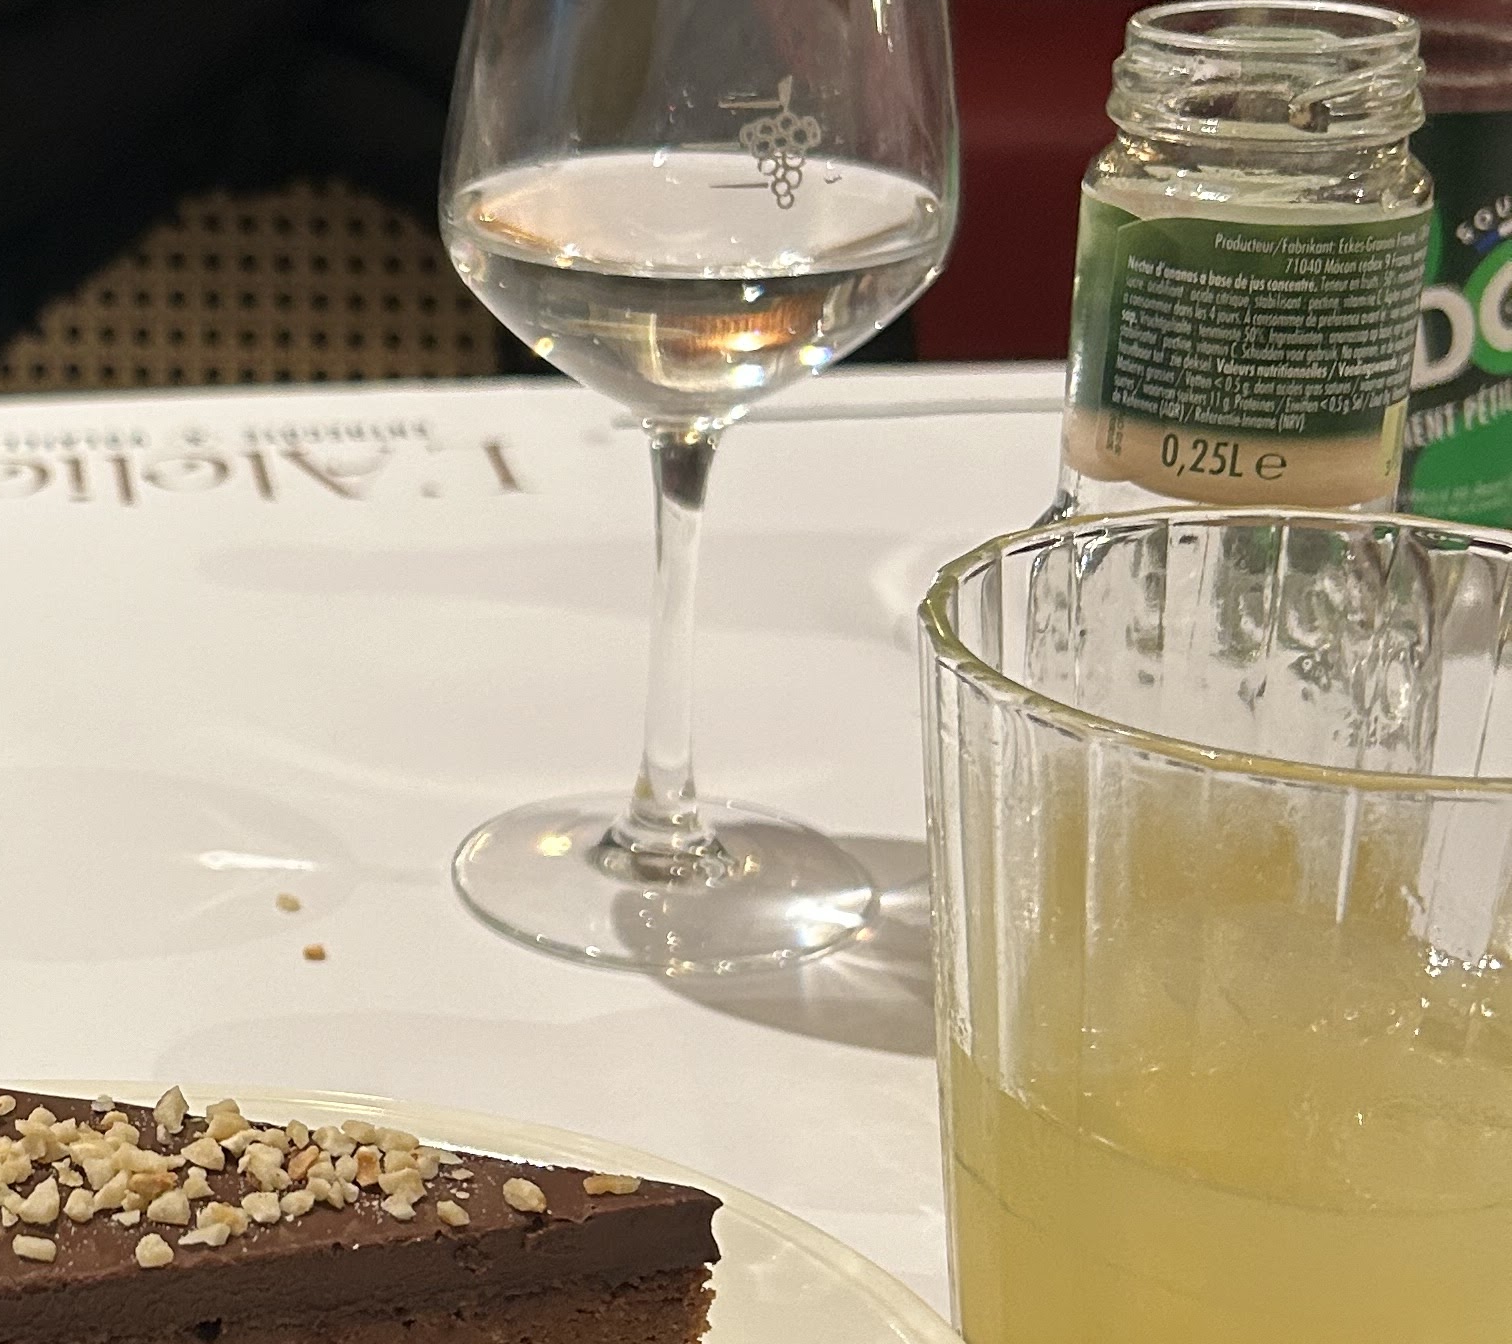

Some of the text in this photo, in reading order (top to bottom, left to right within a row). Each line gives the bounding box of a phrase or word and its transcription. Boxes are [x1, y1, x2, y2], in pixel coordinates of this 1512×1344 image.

[1234, 272, 1248, 290] de
[1249, 274, 1266, 295] jus
[1216, 358, 1255, 378] Valeurs
[1161, 433, 1243, 478] 0,25L
